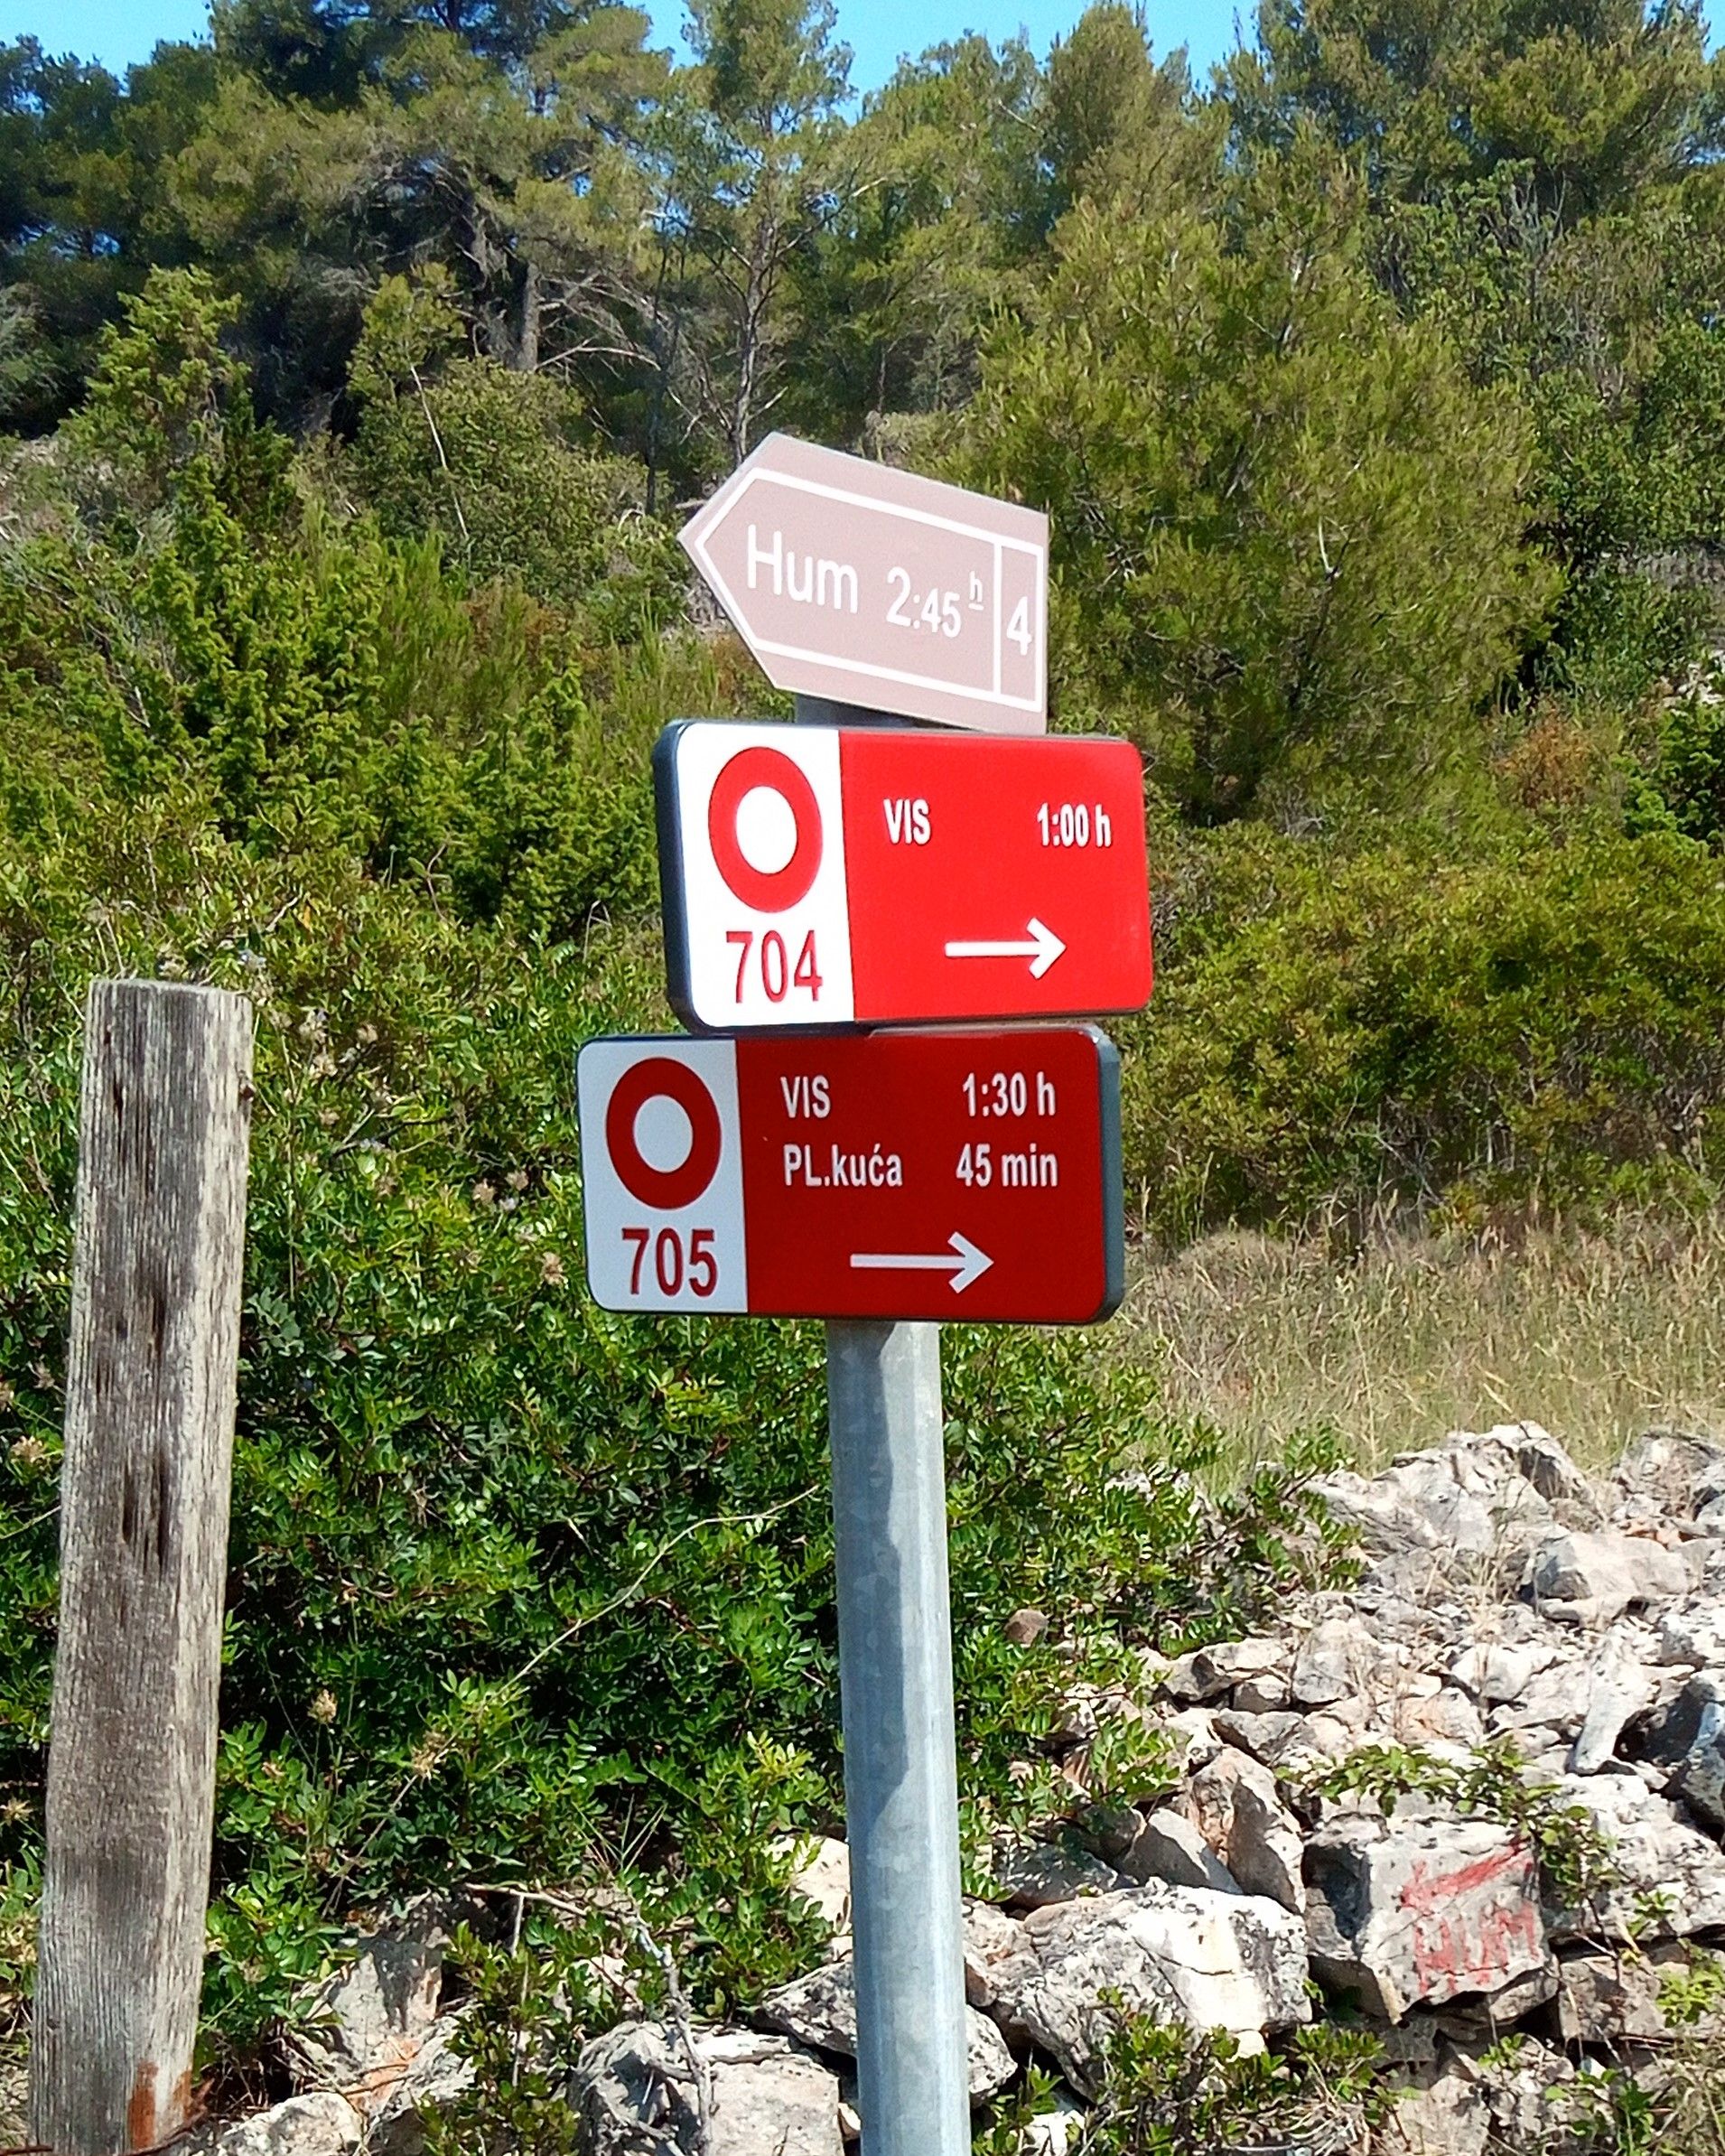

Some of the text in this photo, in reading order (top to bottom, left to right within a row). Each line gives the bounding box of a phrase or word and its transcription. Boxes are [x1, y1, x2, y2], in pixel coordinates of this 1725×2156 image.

[747, 524, 858, 614] Hum
[1006, 596, 1032, 656] 4
[883, 798, 931, 845] VIS
[1037, 802, 1089, 847] 1:00
[725, 929, 823, 1004] 704
[780, 1071, 1056, 1118] VIS 1:30 h
[783, 1143, 1058, 1187] PL.kuća 45 min
[621, 1227, 718, 1297] 705
